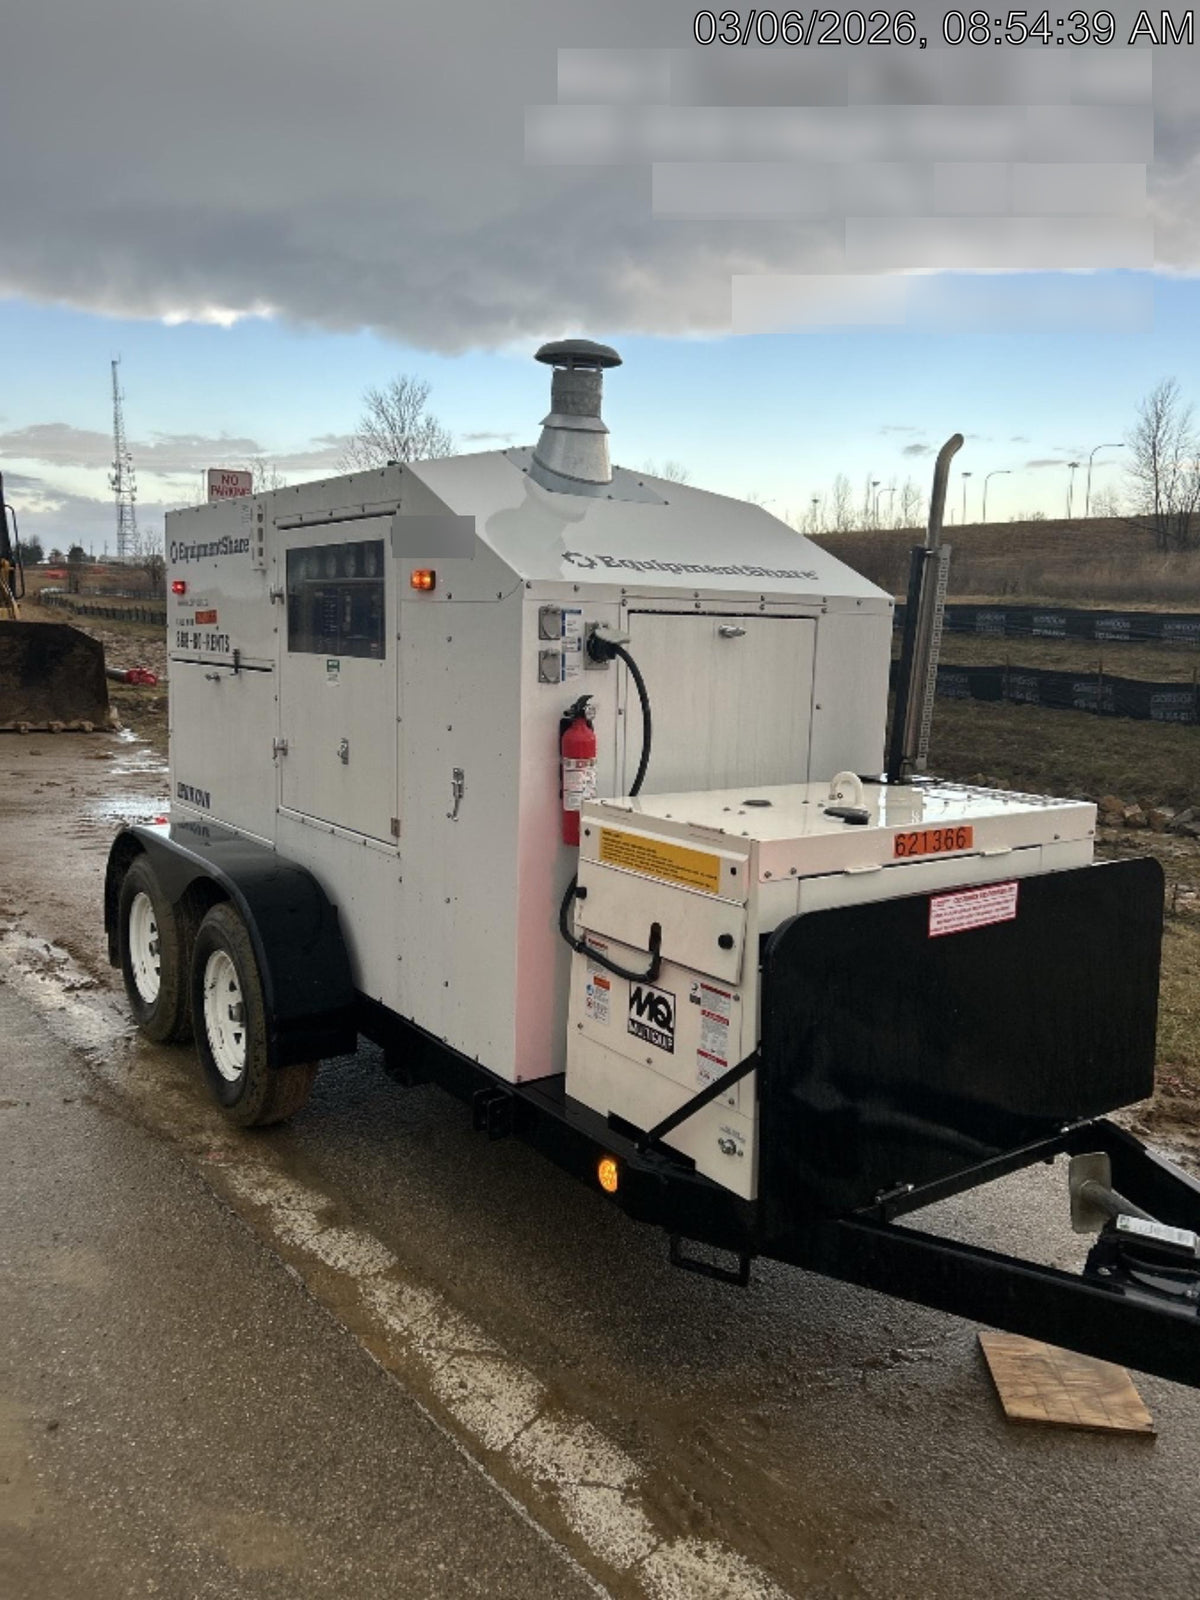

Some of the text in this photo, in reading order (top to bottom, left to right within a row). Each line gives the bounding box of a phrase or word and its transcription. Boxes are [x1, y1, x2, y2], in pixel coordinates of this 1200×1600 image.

[221, 474, 239, 486] NO
[179, 535, 250, 563] EquipmentShare
[595, 554, 819, 580] EquipmentShare
[895, 826, 967, 856] 621366
[630, 986, 675, 1034] MQ
